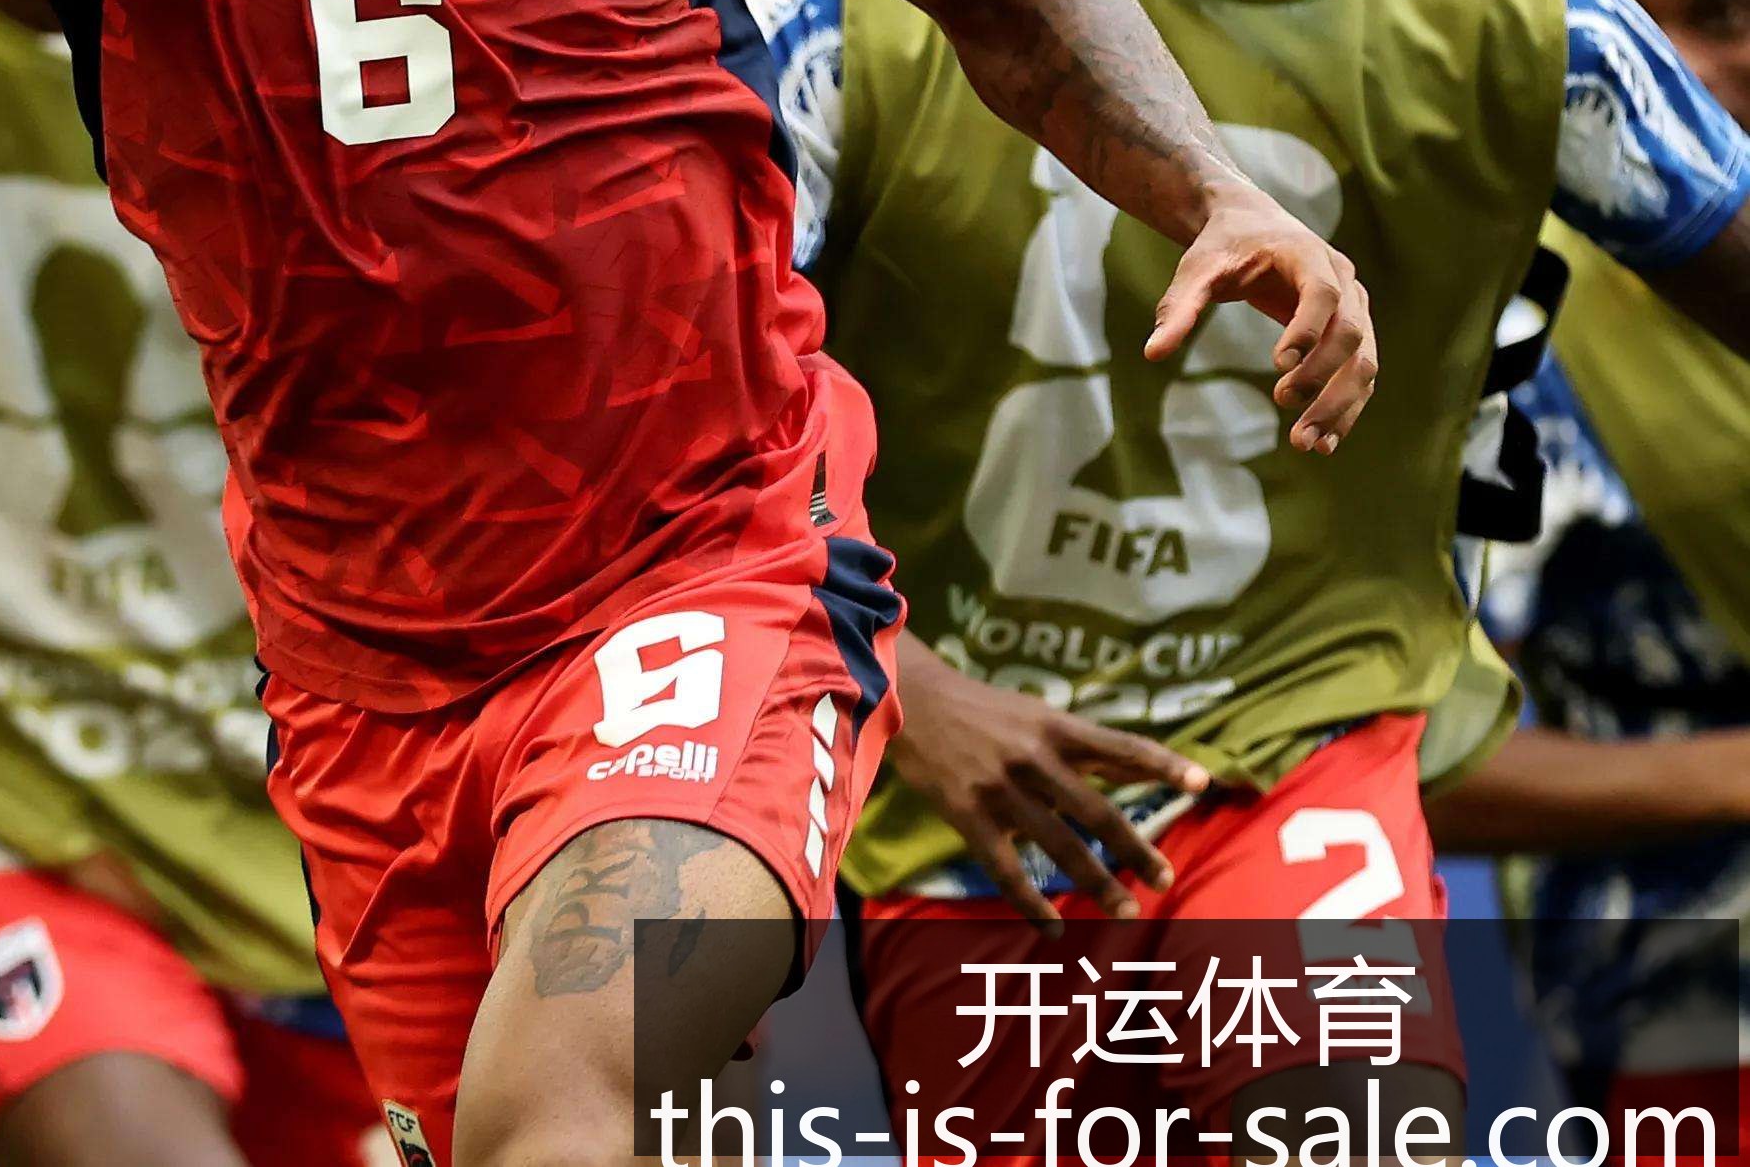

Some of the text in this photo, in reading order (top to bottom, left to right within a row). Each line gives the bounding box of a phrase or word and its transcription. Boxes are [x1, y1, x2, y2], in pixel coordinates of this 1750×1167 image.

[1047, 512, 1189, 576] FIFA
[593, 611, 725, 748] 6
[637, 764, 713, 784] SPORT
[1278, 808, 1424, 967] 2
